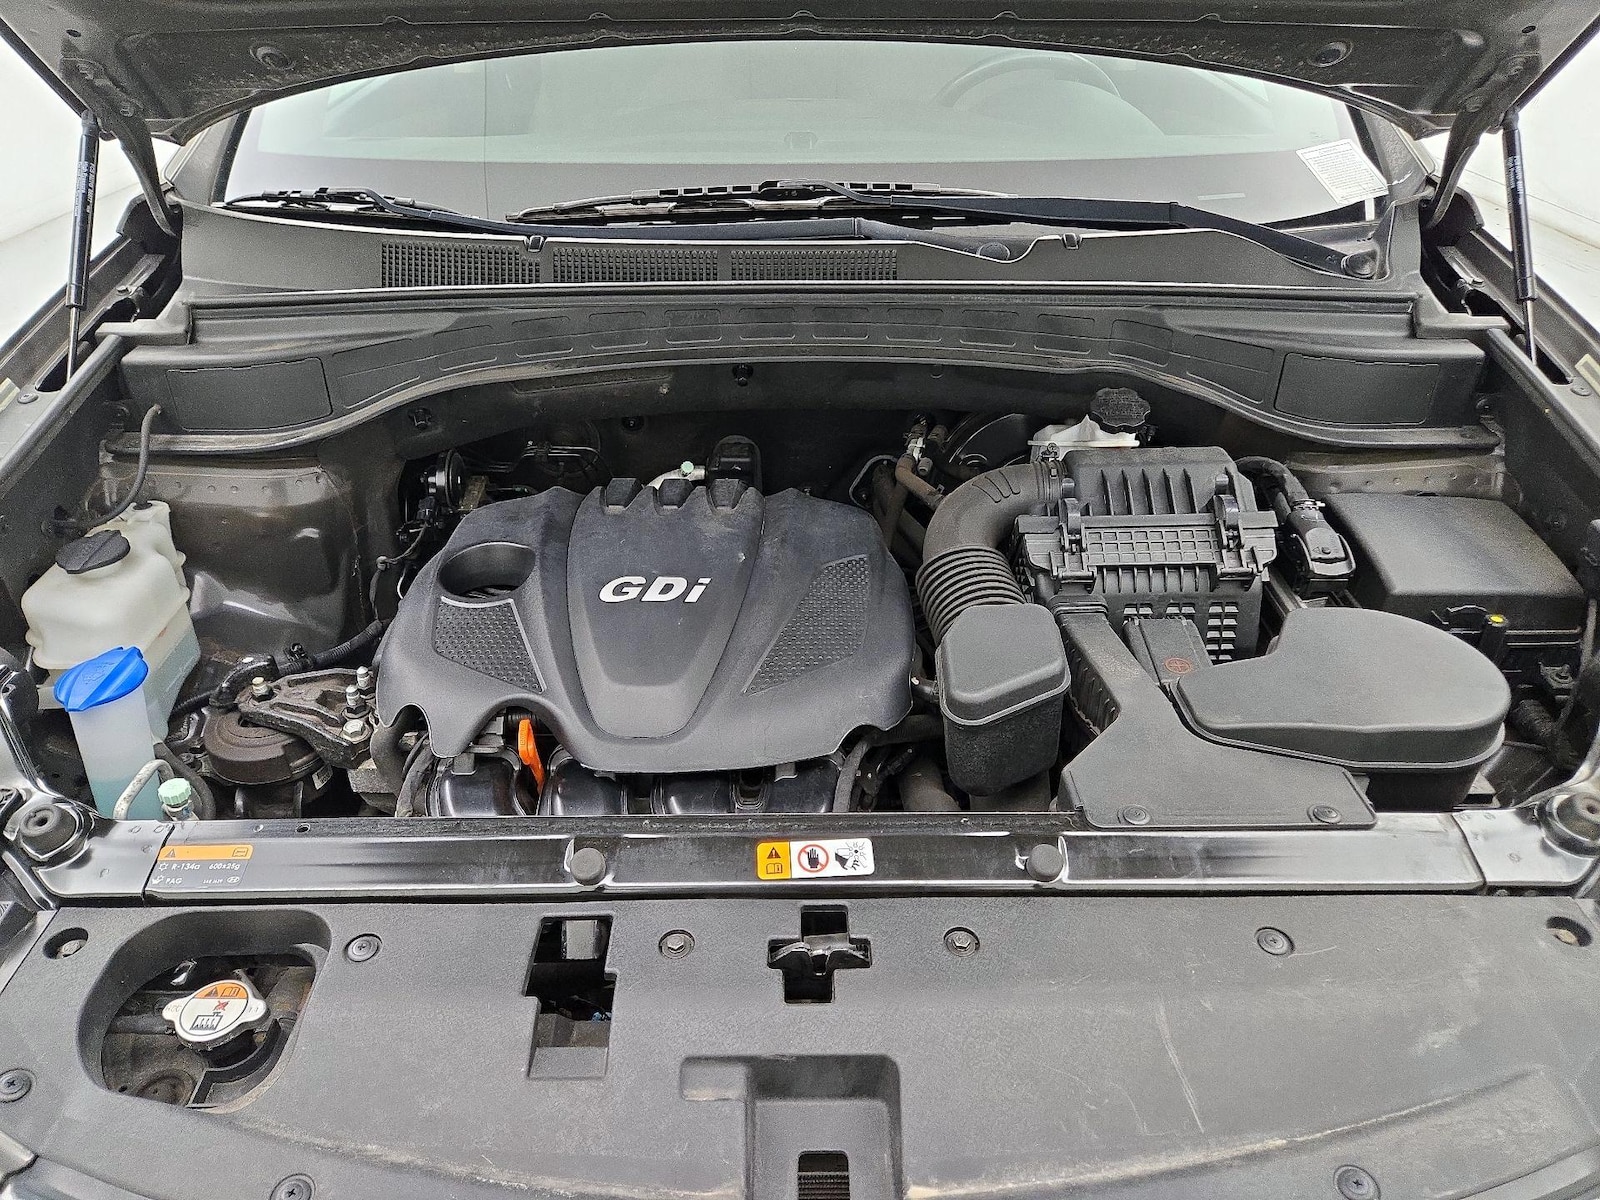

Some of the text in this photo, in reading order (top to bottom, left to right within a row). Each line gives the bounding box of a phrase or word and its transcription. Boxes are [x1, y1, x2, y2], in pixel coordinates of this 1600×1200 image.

[599, 575, 712, 603] GDi
[171, 862, 201, 871] R-134a
[165, 877, 183, 885] PAG
